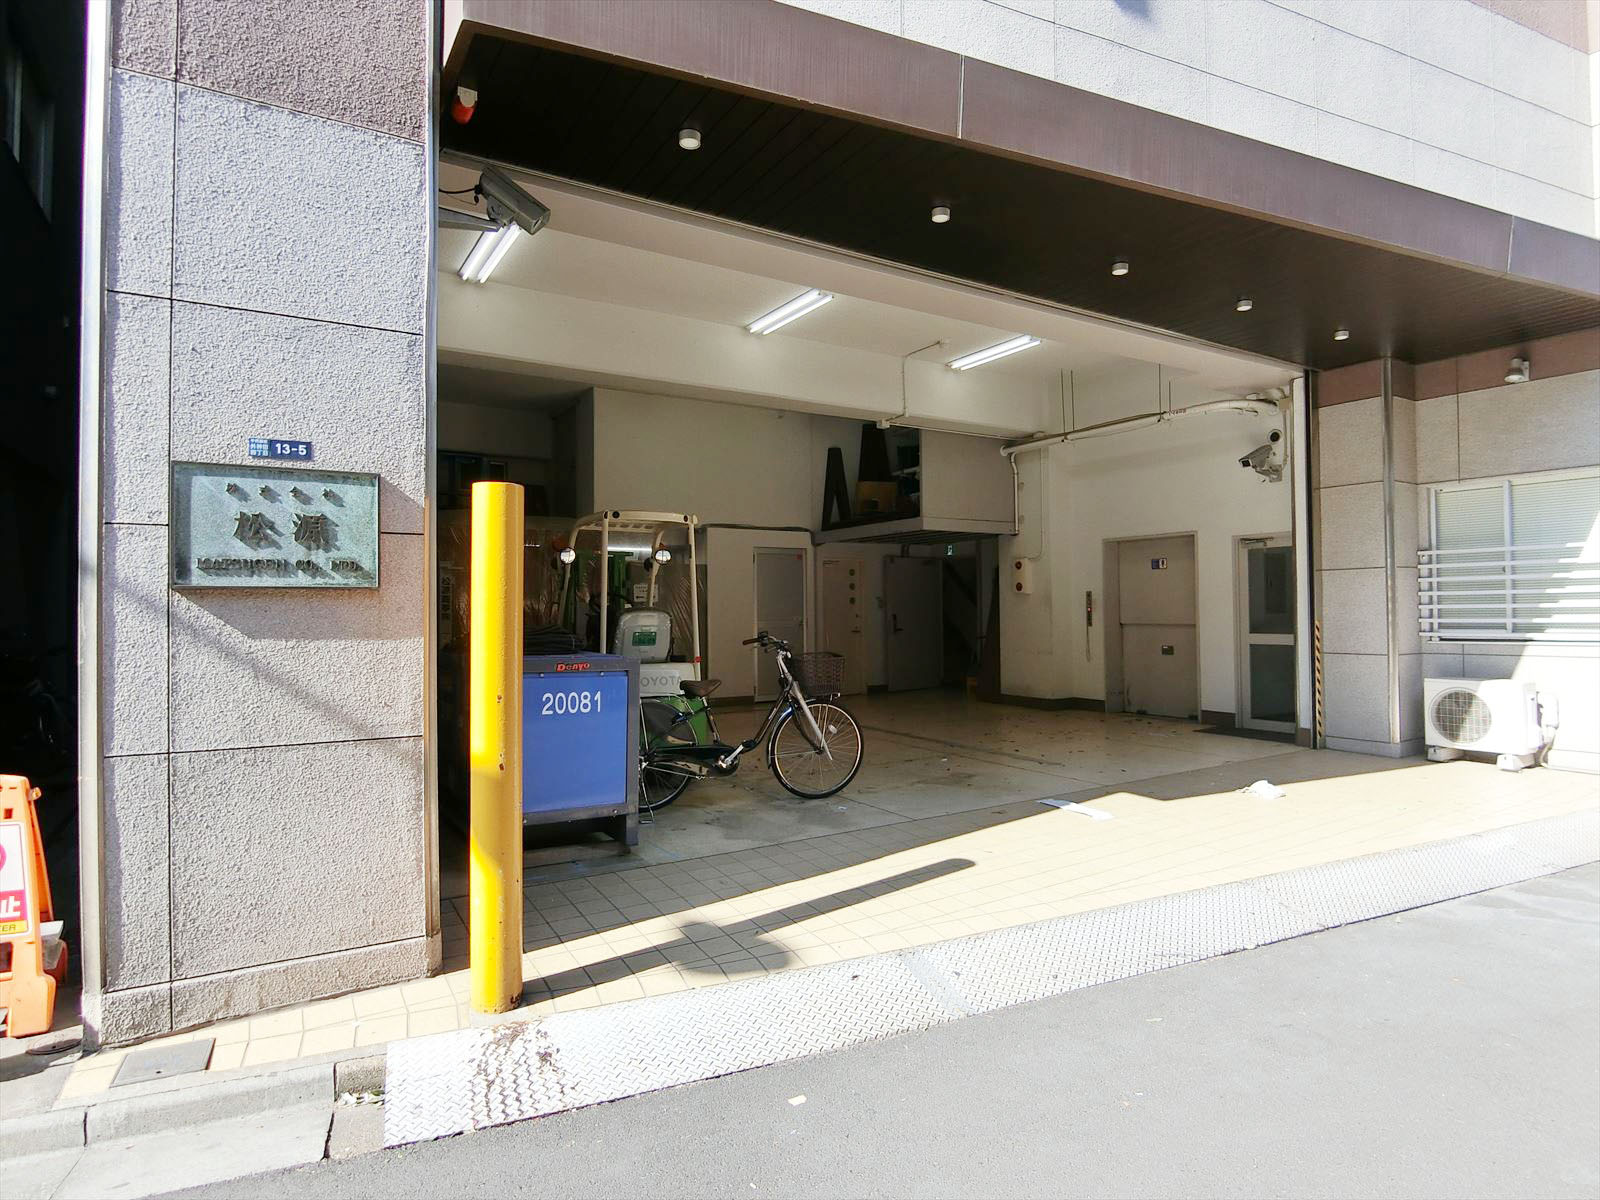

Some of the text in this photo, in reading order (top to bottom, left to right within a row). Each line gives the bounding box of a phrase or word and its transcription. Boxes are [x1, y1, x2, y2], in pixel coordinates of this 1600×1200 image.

[275, 443, 307, 456] 13-5
[556, 662, 591, 672] Denyo
[640, 675, 682, 687] OYOTA
[541, 690, 602, 716] 20081
